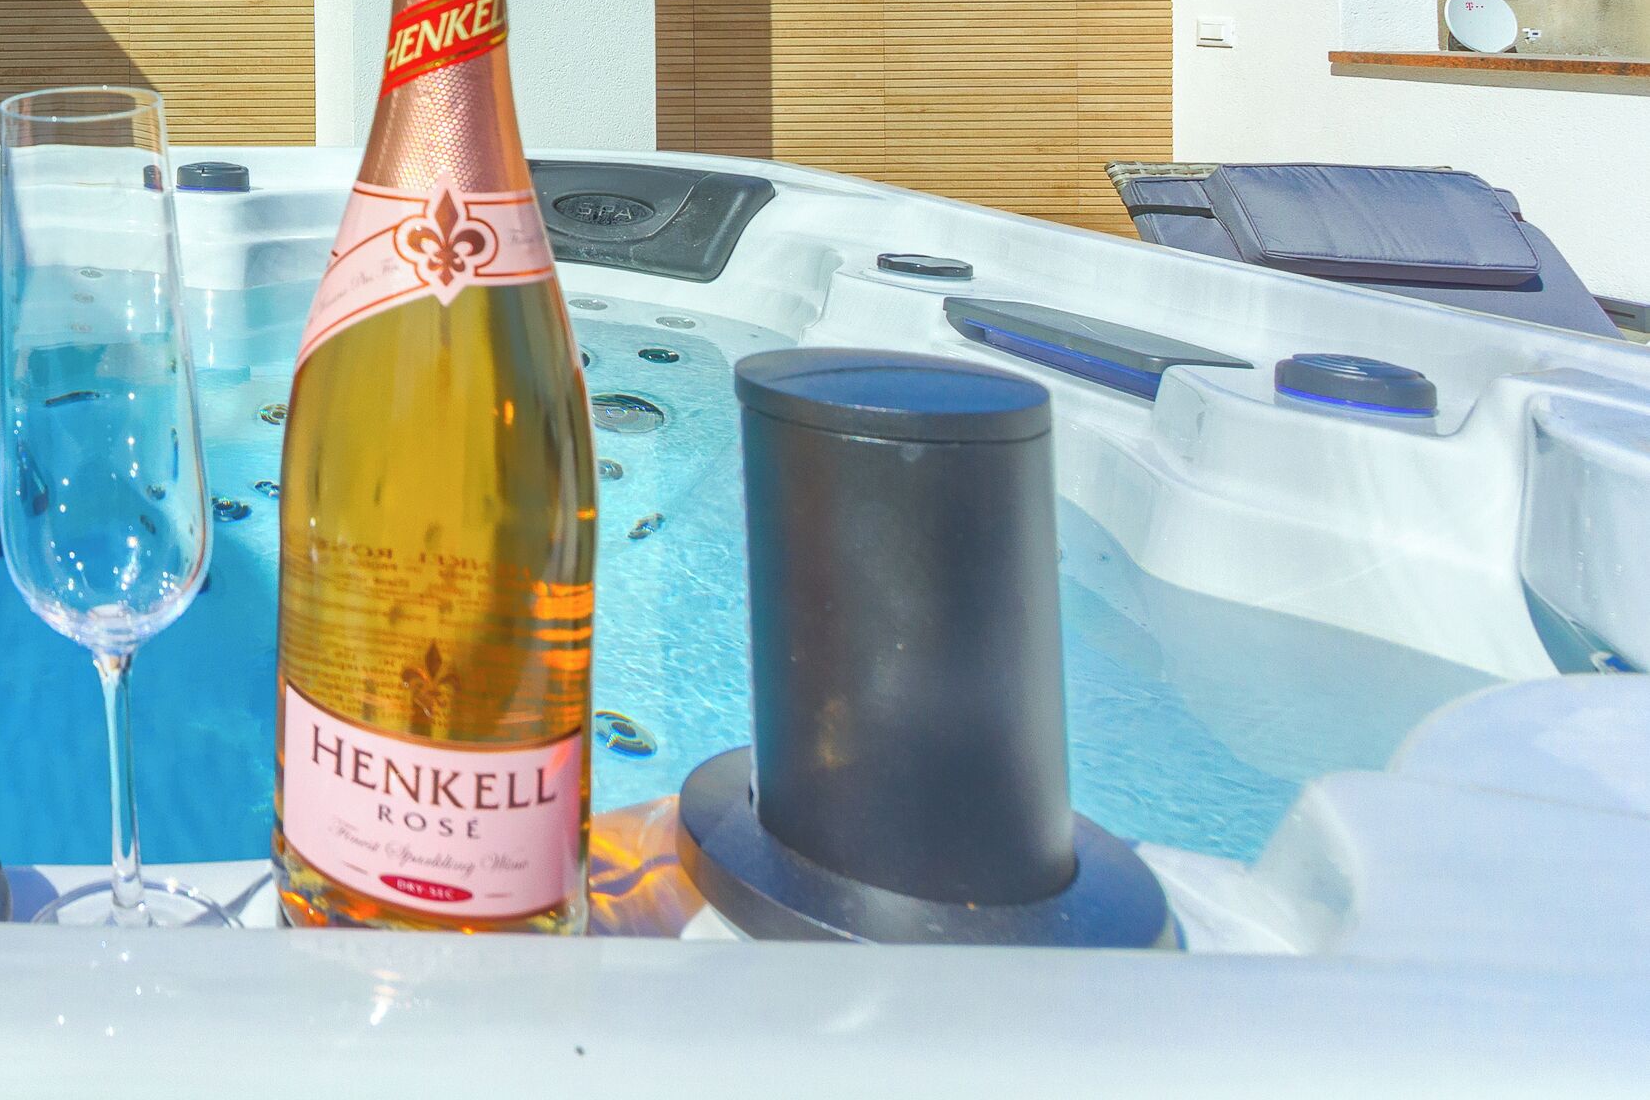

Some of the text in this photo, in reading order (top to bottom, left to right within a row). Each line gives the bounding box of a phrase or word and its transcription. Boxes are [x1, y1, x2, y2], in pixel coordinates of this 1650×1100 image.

[578, 202, 632, 220] SPA
[311, 724, 558, 810] HENKELL
[378, 803, 481, 839] ROSÉ
